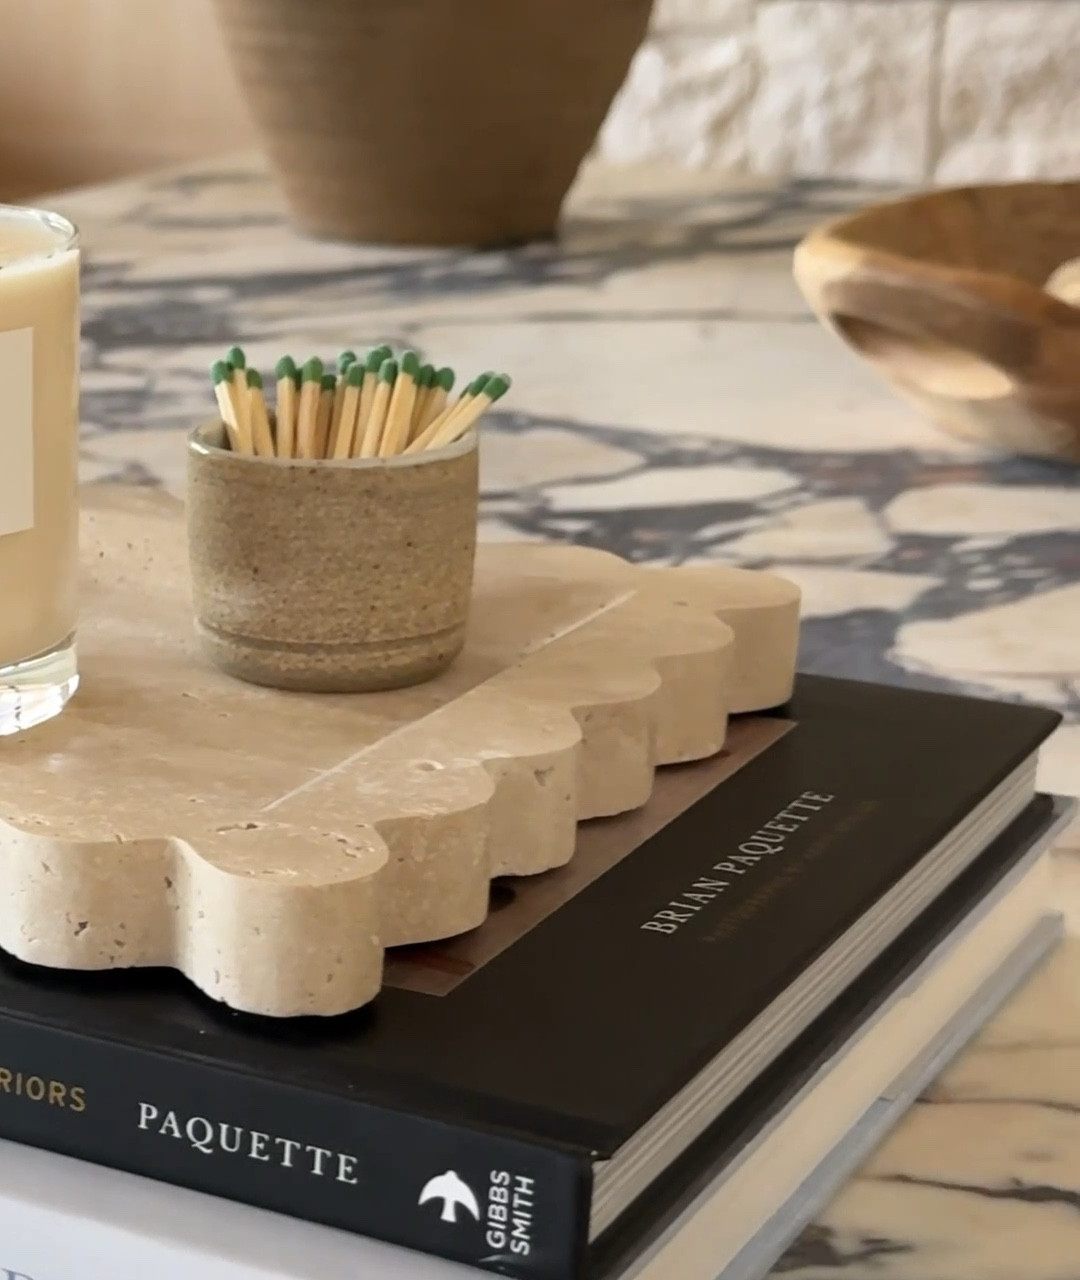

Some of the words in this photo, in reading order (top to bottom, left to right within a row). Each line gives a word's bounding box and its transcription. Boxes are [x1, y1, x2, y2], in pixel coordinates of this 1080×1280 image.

[640, 877, 730, 934] BRIAN
[713, 790, 836, 874] PAQUETTE
[137, 1101, 359, 1186] PAQUETTE
[486, 1170, 510, 1249] GIBBS
[510, 1175, 534, 1256] SMITH
